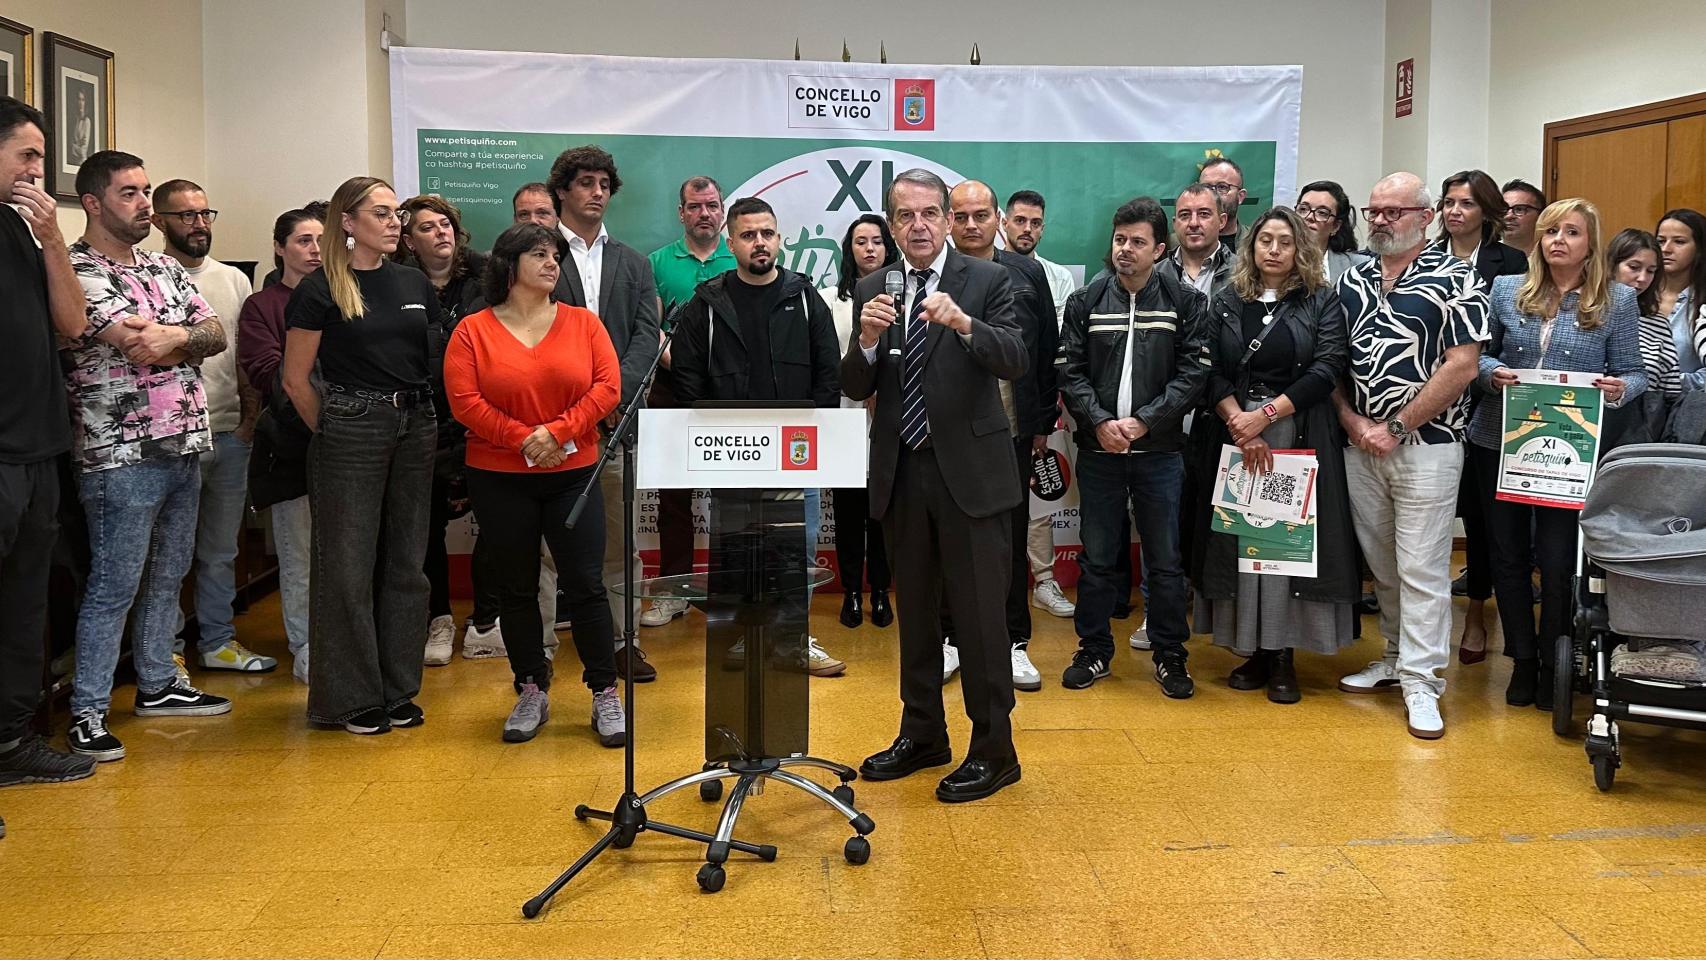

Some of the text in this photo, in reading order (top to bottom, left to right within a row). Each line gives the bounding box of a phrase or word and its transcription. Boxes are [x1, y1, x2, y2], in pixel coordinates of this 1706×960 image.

[795, 87, 881, 103] CONCELLO
[806, 104, 871, 119] DE VIGO
[424, 136, 517, 147] www.petisquiño.com
[425, 149, 468, 160] Comparte
[478, 150, 492, 159] túa
[494, 151, 544, 161] experiencia
[438, 159, 473, 170] hashtag
[475, 161, 527, 170] #petisquiño
[444, 181, 499, 189] Petisquiño Vigo
[825, 159, 894, 212] XI
[694, 435, 770, 448] CONCELLO
[1542, 438, 1556, 450] XI
[703, 450, 762, 461] DE VIGO
[1035, 459, 1052, 495] Estrella
[1047, 456, 1063, 491] Galicia
